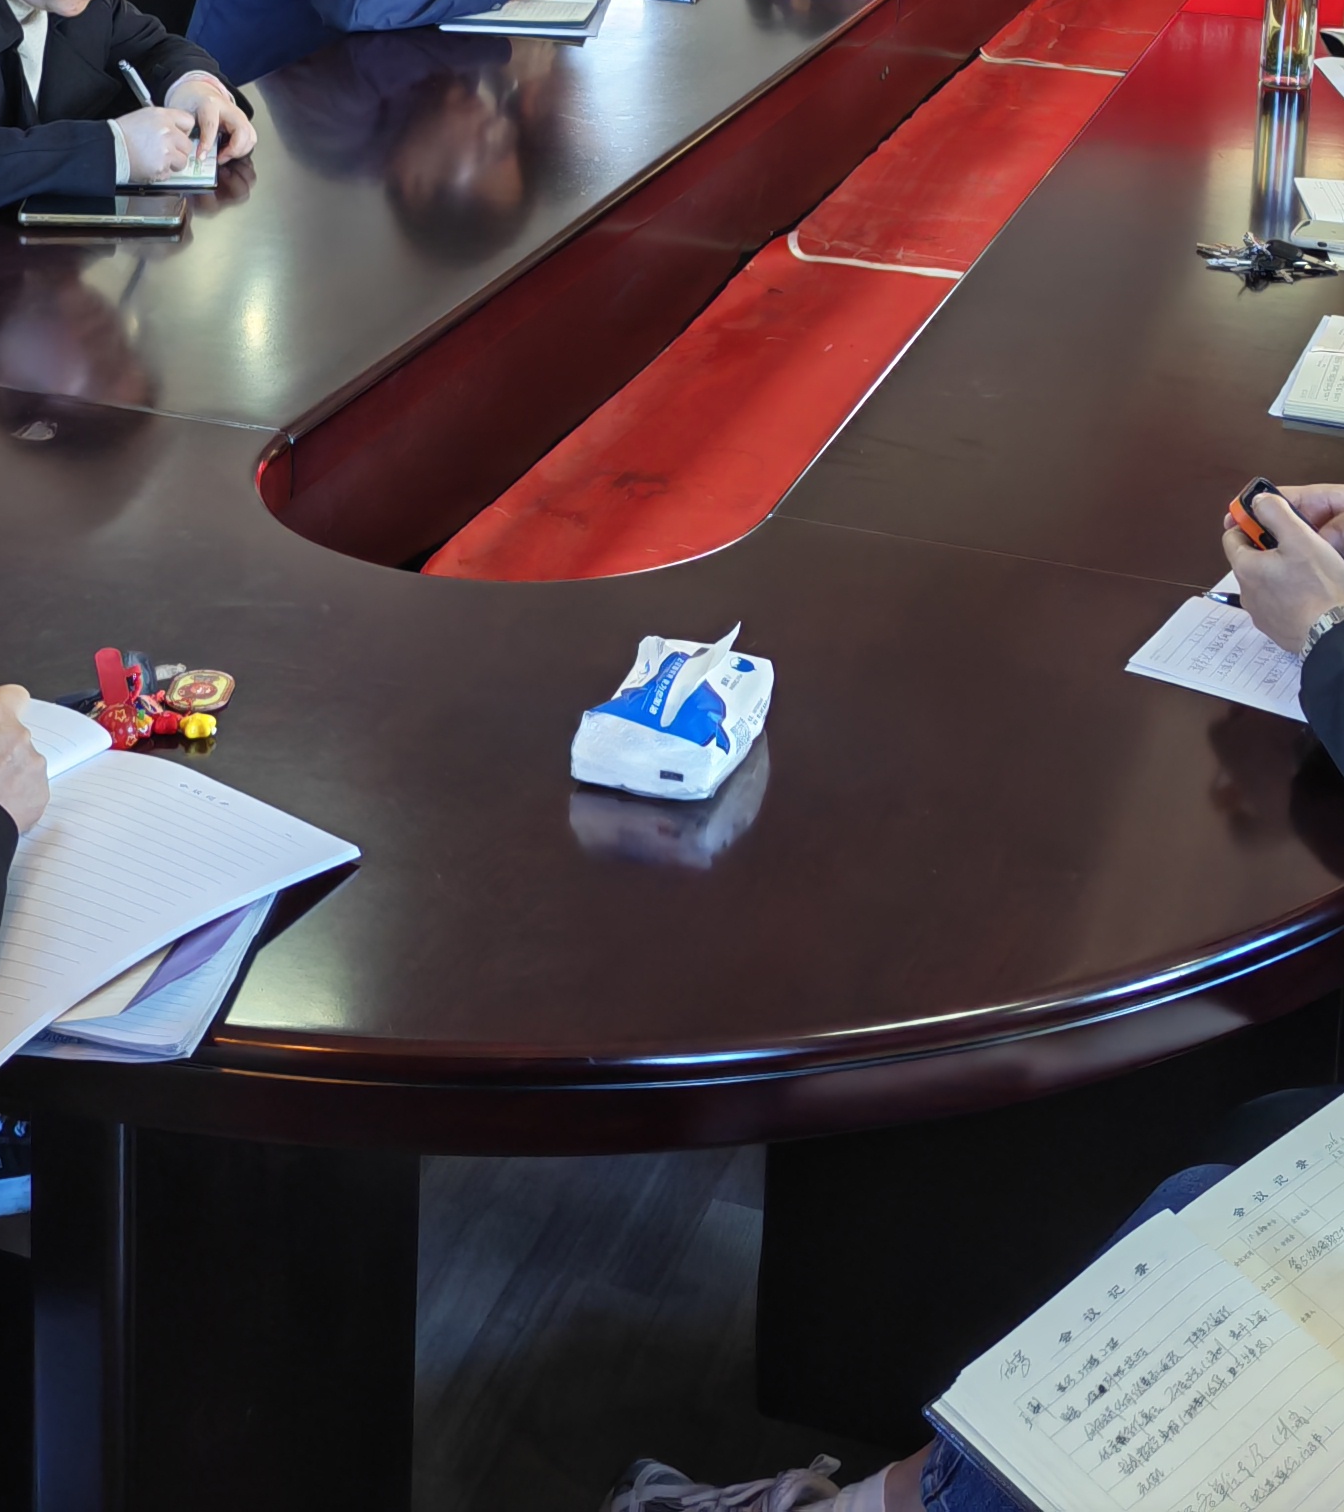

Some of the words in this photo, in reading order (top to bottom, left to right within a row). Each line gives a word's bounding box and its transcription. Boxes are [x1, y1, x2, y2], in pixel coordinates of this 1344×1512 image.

[1233, 1159, 1309, 1218] 会议记录
[1059, 1262, 1149, 1344] 会议记录
